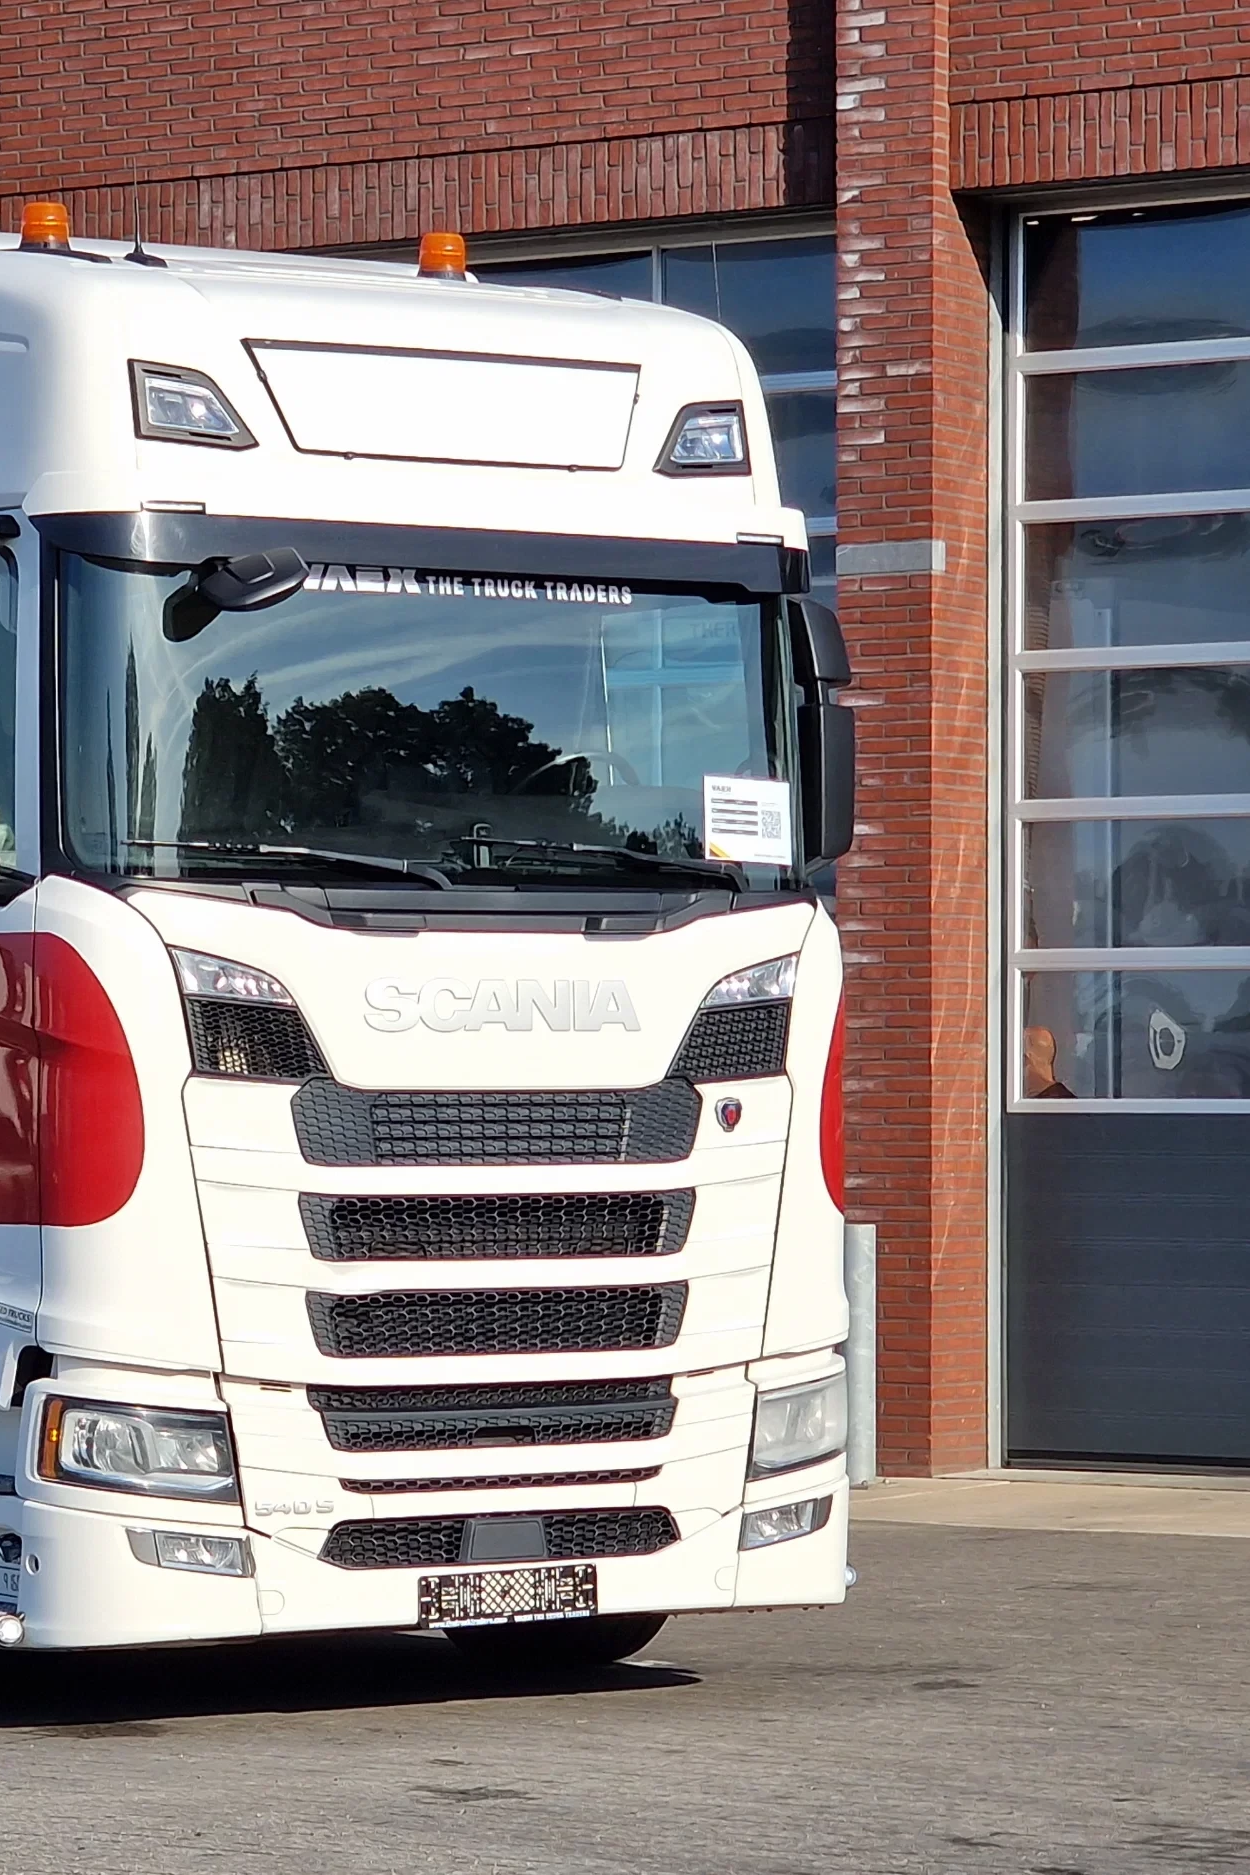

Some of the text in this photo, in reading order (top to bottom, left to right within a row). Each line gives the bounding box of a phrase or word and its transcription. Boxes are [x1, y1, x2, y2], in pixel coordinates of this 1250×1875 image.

[426, 575, 464, 598] THE
[471, 577, 539, 601] TRUCK
[544, 580, 633, 606] TRADERS
[363, 976, 642, 1033] SCANIA
[8, 1308, 31, 1323] TRUCKS
[254, 1500, 334, 1517] 540 S
